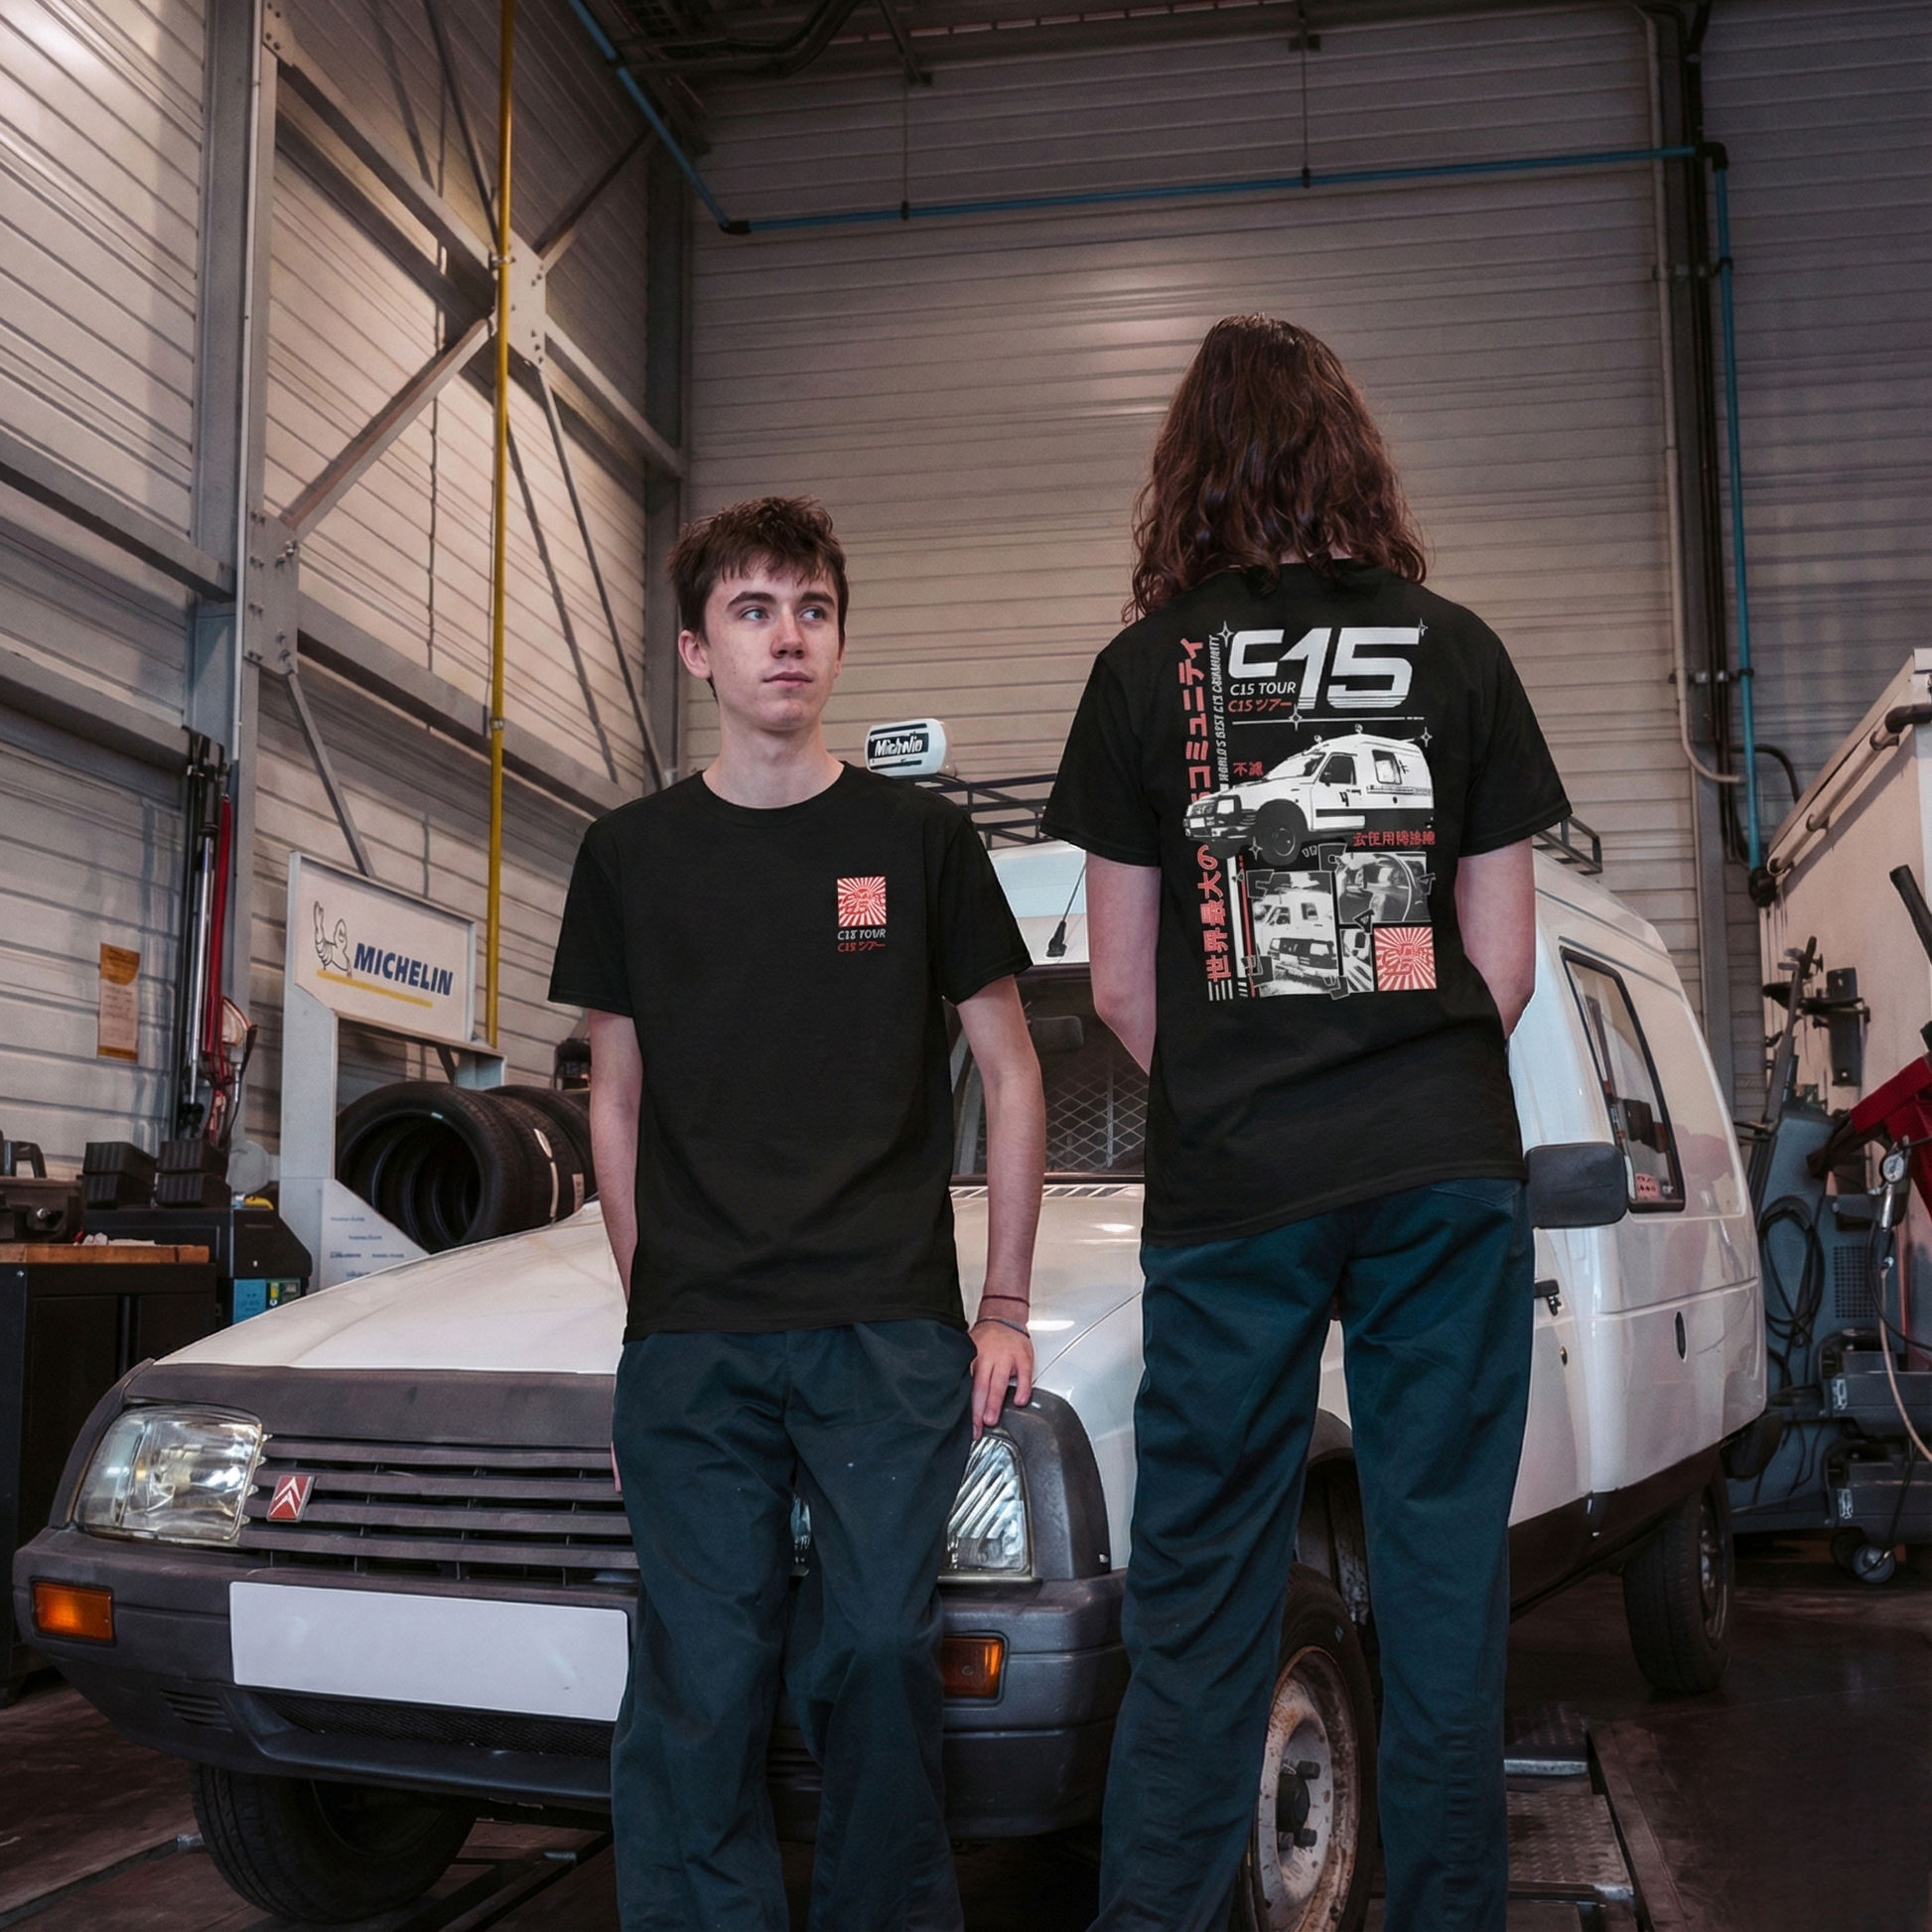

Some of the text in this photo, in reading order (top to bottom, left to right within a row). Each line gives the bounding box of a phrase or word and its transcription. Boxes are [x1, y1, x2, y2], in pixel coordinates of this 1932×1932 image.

[1228, 626, 1420, 709] C15
[1230, 681, 1297, 696] C15 TOUR
[1228, 699, 1253, 713] C15
[859, 928, 886, 939] TOUR
[353, 942, 454, 997] MICHELIN
